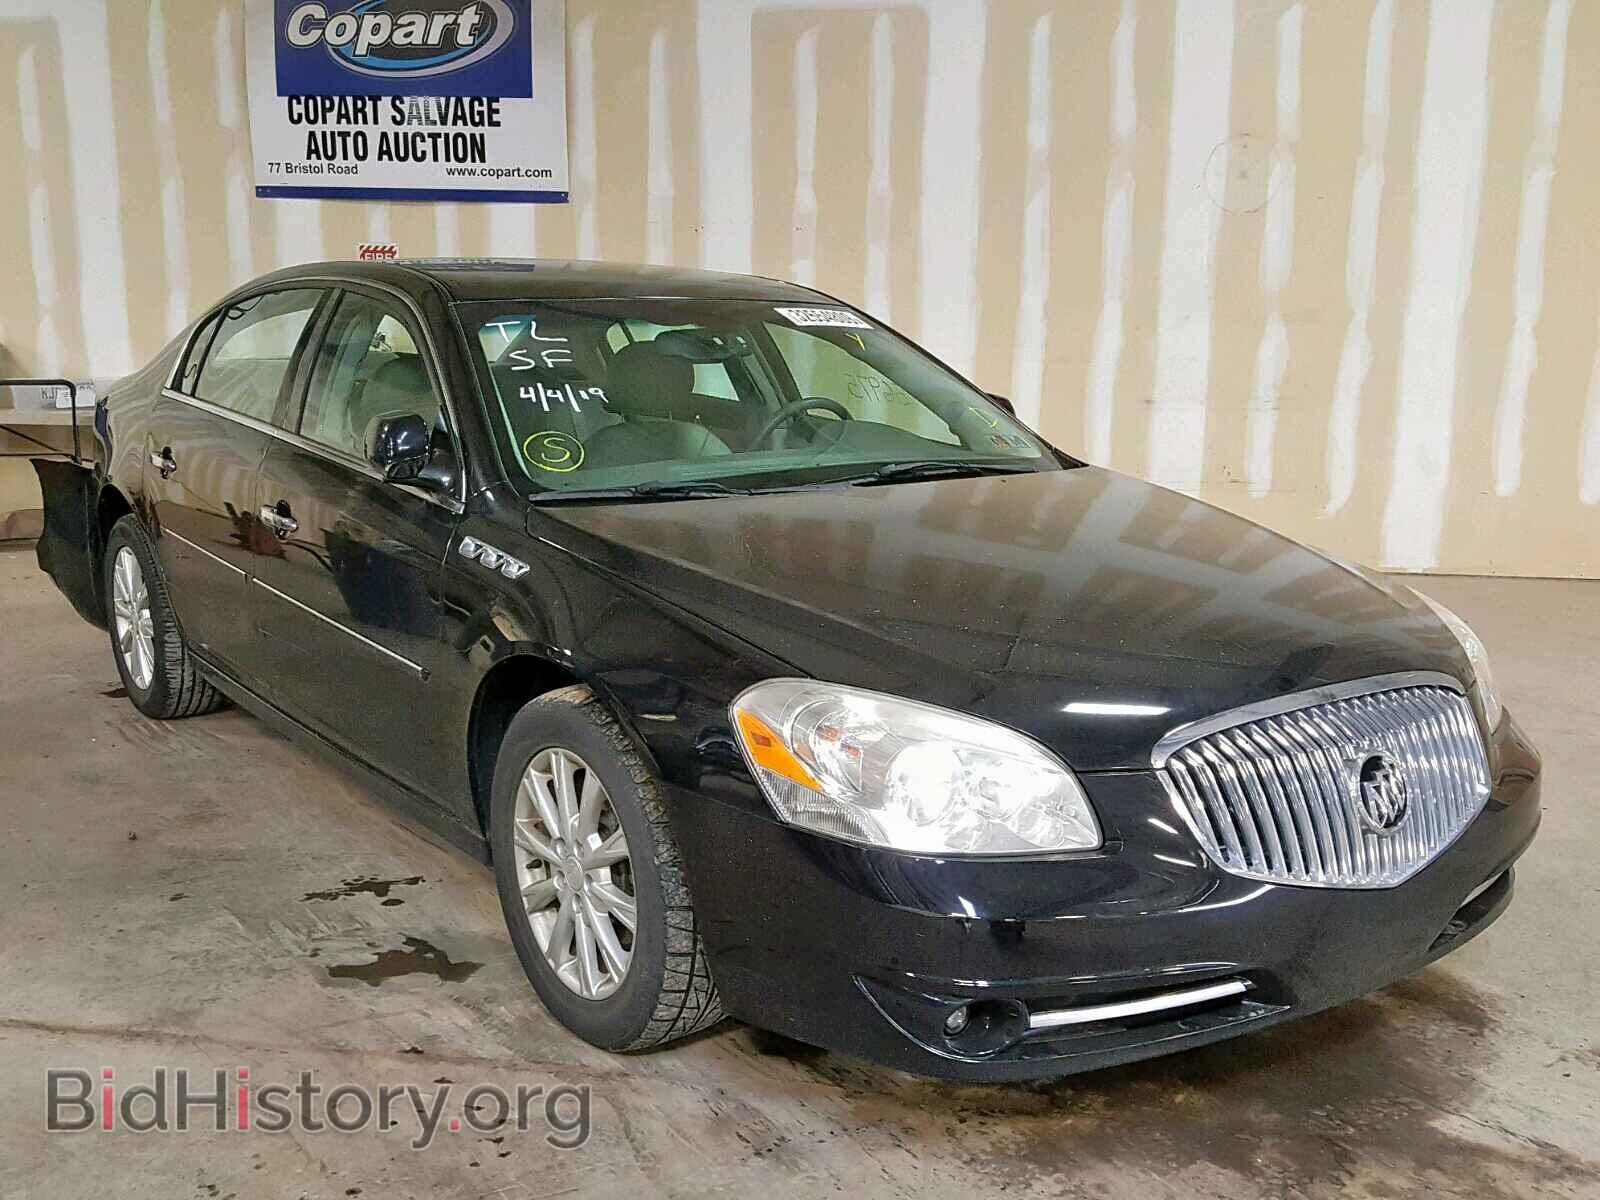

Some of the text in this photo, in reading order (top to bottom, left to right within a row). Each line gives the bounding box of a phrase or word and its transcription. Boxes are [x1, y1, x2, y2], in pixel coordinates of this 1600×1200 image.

[286, 2, 484, 57] Copart
[287, 95, 501, 127] COPART SALVAGE
[305, 131, 487, 163] AUTO AUCTION
[267, 163, 358, 175] 77 Bristol Road
[446, 166, 553, 179] www.copart.com
[519, 382, 609, 413] 4/4/19
